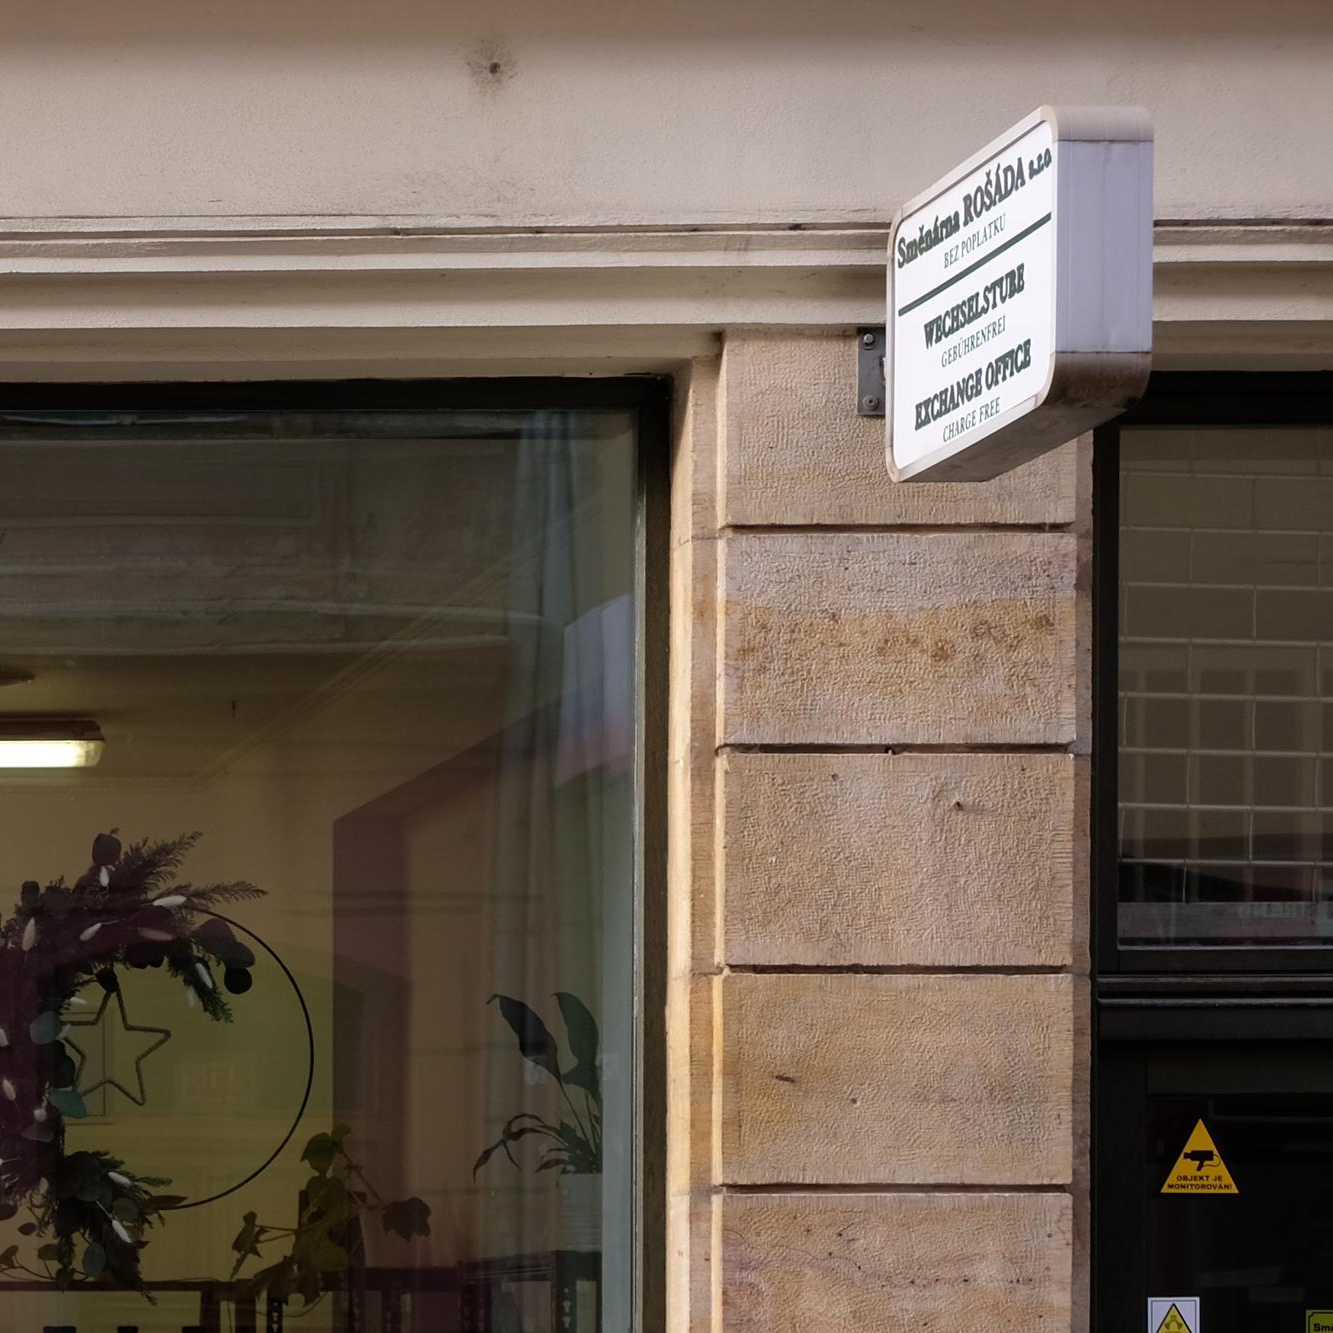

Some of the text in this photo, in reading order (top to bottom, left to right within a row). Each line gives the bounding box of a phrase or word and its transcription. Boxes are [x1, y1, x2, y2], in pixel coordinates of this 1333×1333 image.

[898, 210, 960, 269] Směnárna
[963, 157, 1026, 227] ROŠÁDA
[944, 213, 1006, 269] BEZ POPLATKU
[923, 262, 1025, 349] WECHSELSTUBE
[941, 315, 1006, 368] GEBÜHRENFREI
[914, 338, 1031, 431] EXCHANGE OFFICE
[942, 397, 1000, 442] CHARGE FREE
